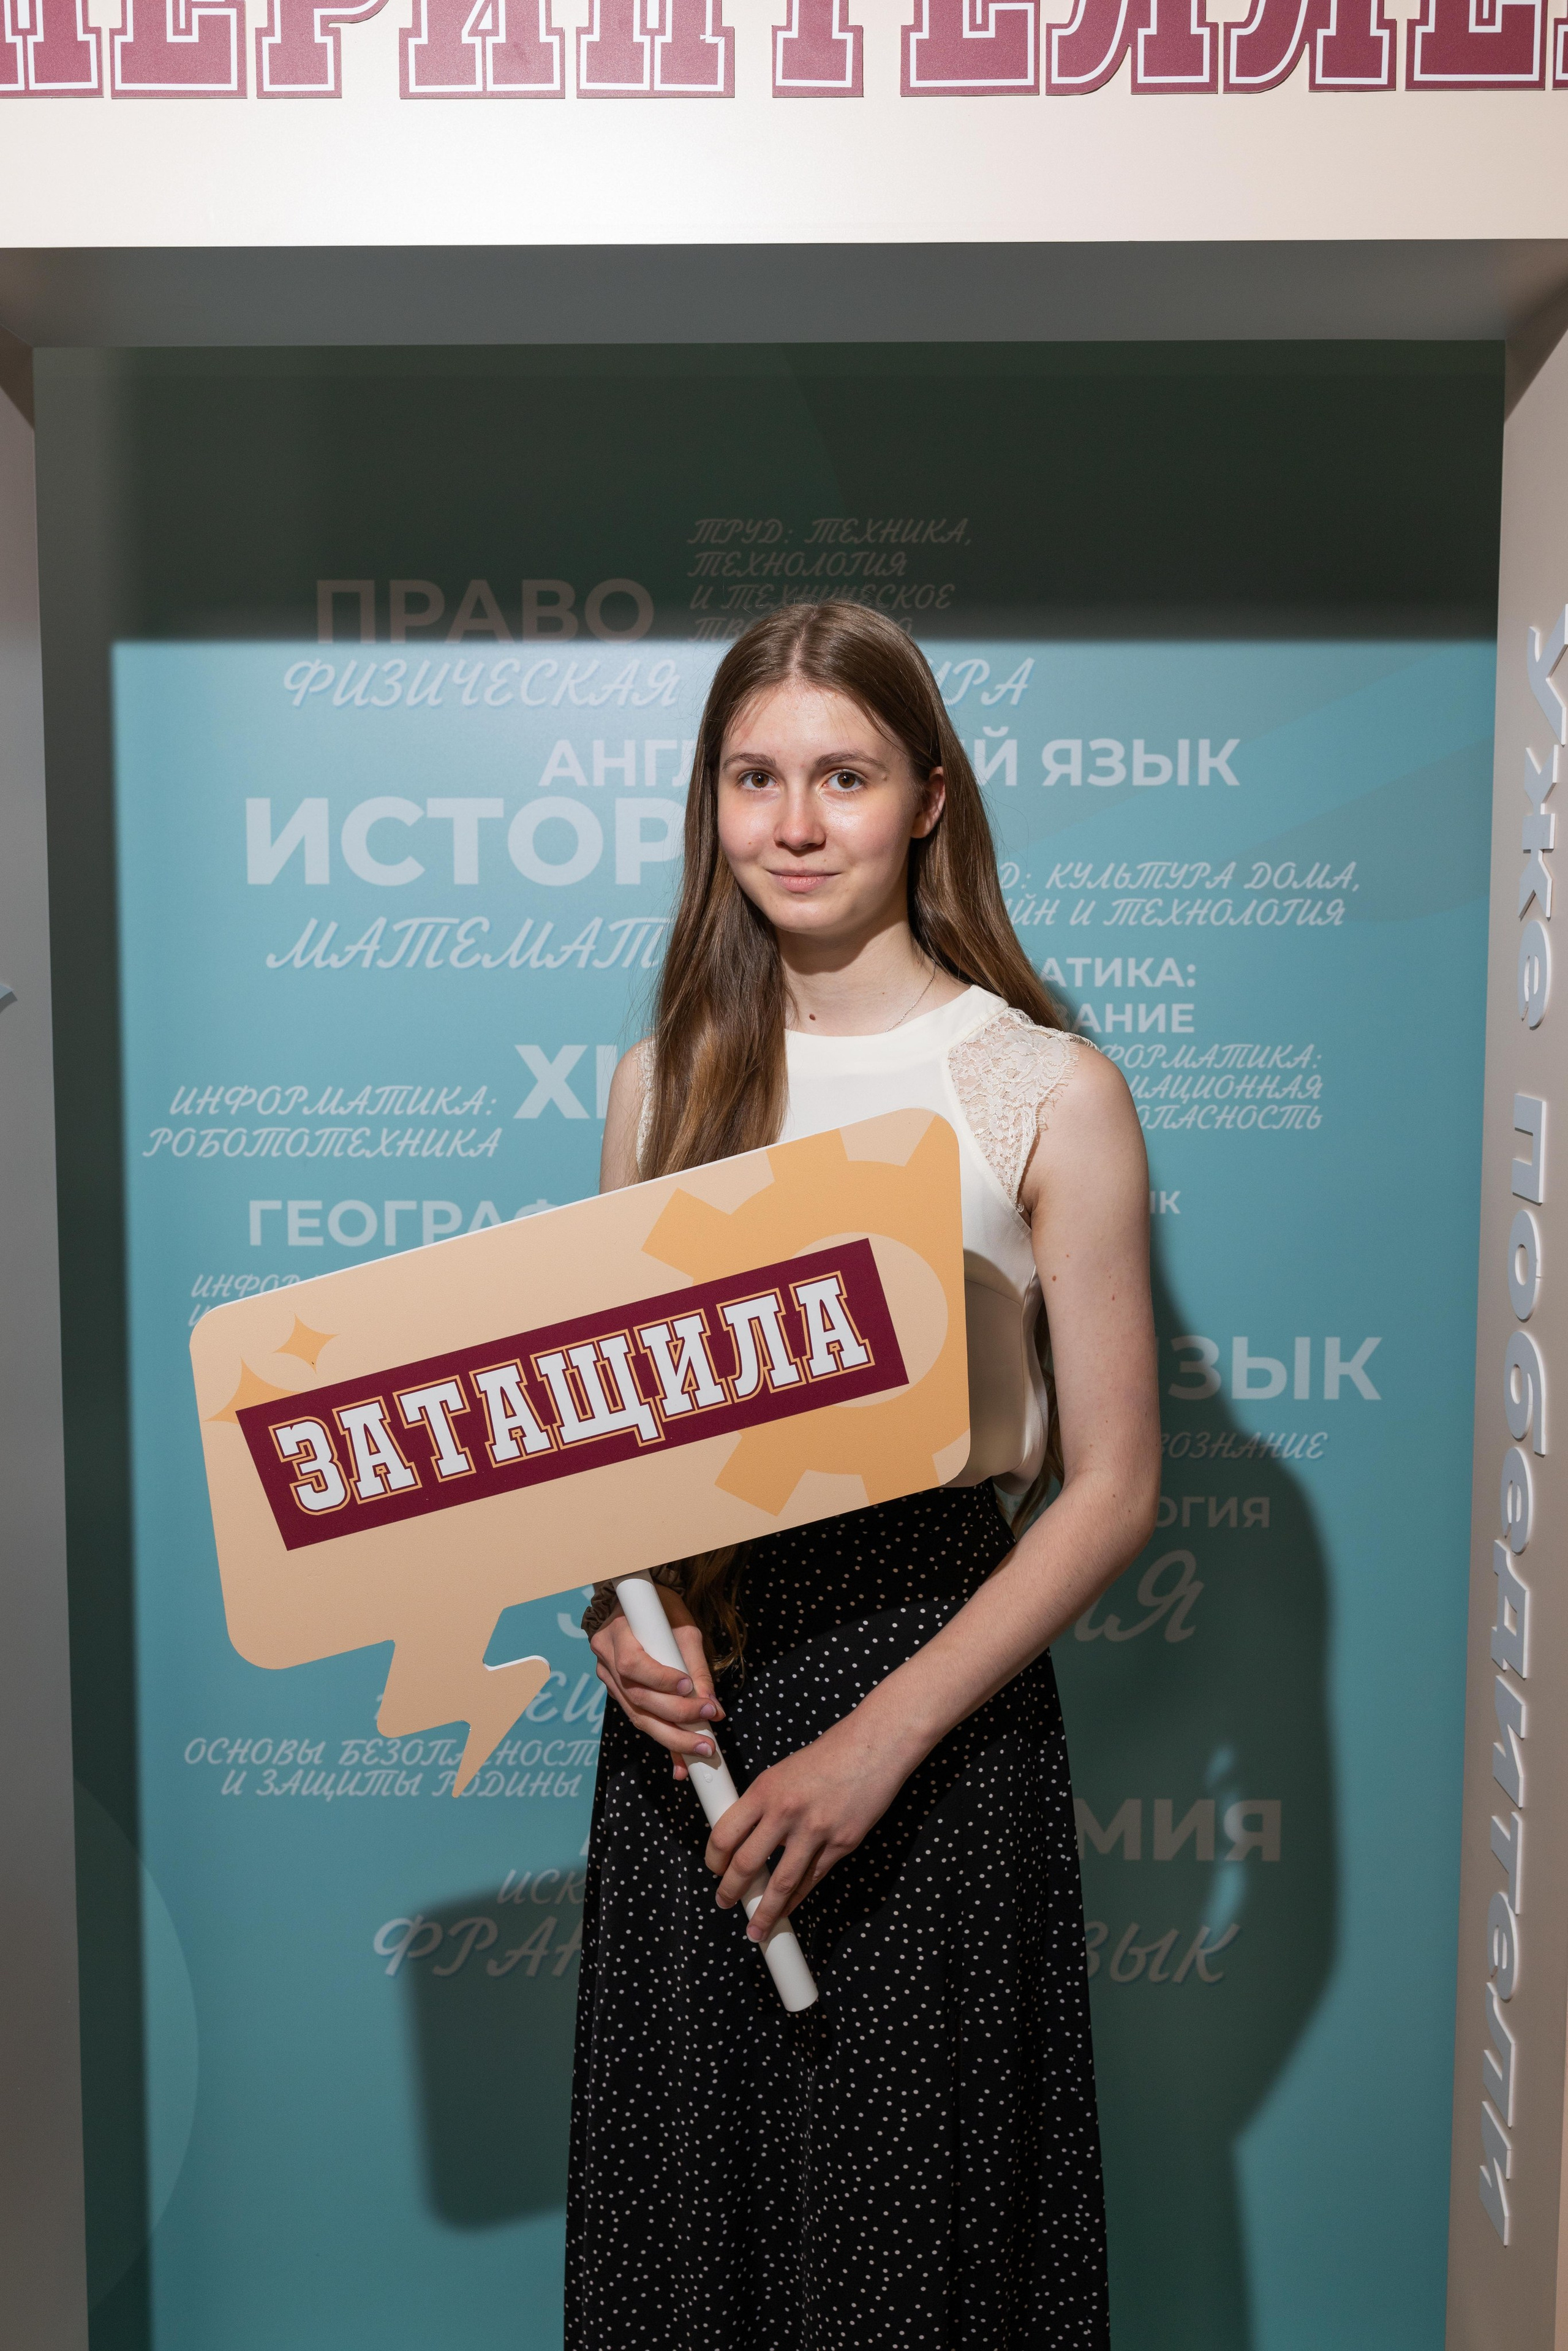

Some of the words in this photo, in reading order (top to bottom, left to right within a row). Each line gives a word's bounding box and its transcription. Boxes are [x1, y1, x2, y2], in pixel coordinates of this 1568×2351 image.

[687, 518, 794, 545] ТРУД:
[804, 518, 973, 545] ТЕХНИКА,
[687, 551, 908, 577] ТЕХНОЛОГИЯ
[316, 578, 655, 644] ПРАВО
[689, 584, 717, 609] И
[283, 658, 680, 707] ФИЗИЧЕСКАЯ
[1041, 738, 1241, 787] ЯЗЫК
[245, 796, 687, 886] ИСТОР
[1045, 861, 1237, 890] КУЛЬТУРА
[1243, 861, 1361, 892] ДОМА,
[1069, 899, 1096, 926] И
[1102, 897, 1346, 926] ТЕХНОЛОГИЯ
[265, 916, 671, 969] МАТЕМАТ
[1101, 1044, 1322, 1069] ФОРМАТИКА:
[168, 1084, 497, 1116] ИНФОРМАТИКА:
[142, 1126, 503, 1158] РОБОТОТЕХНИКА
[1156, 1334, 1383, 1400] ЗЫК
[269, 1270, 875, 1516] ЗАТАЩИЛА
[1478, 1092, 1547, 2247] победители
[184, 1738, 323, 1767] ОСНОВЫ
[221, 1770, 244, 1797] И
[256, 1770, 421, 1803] ЗАЩИТЫ
